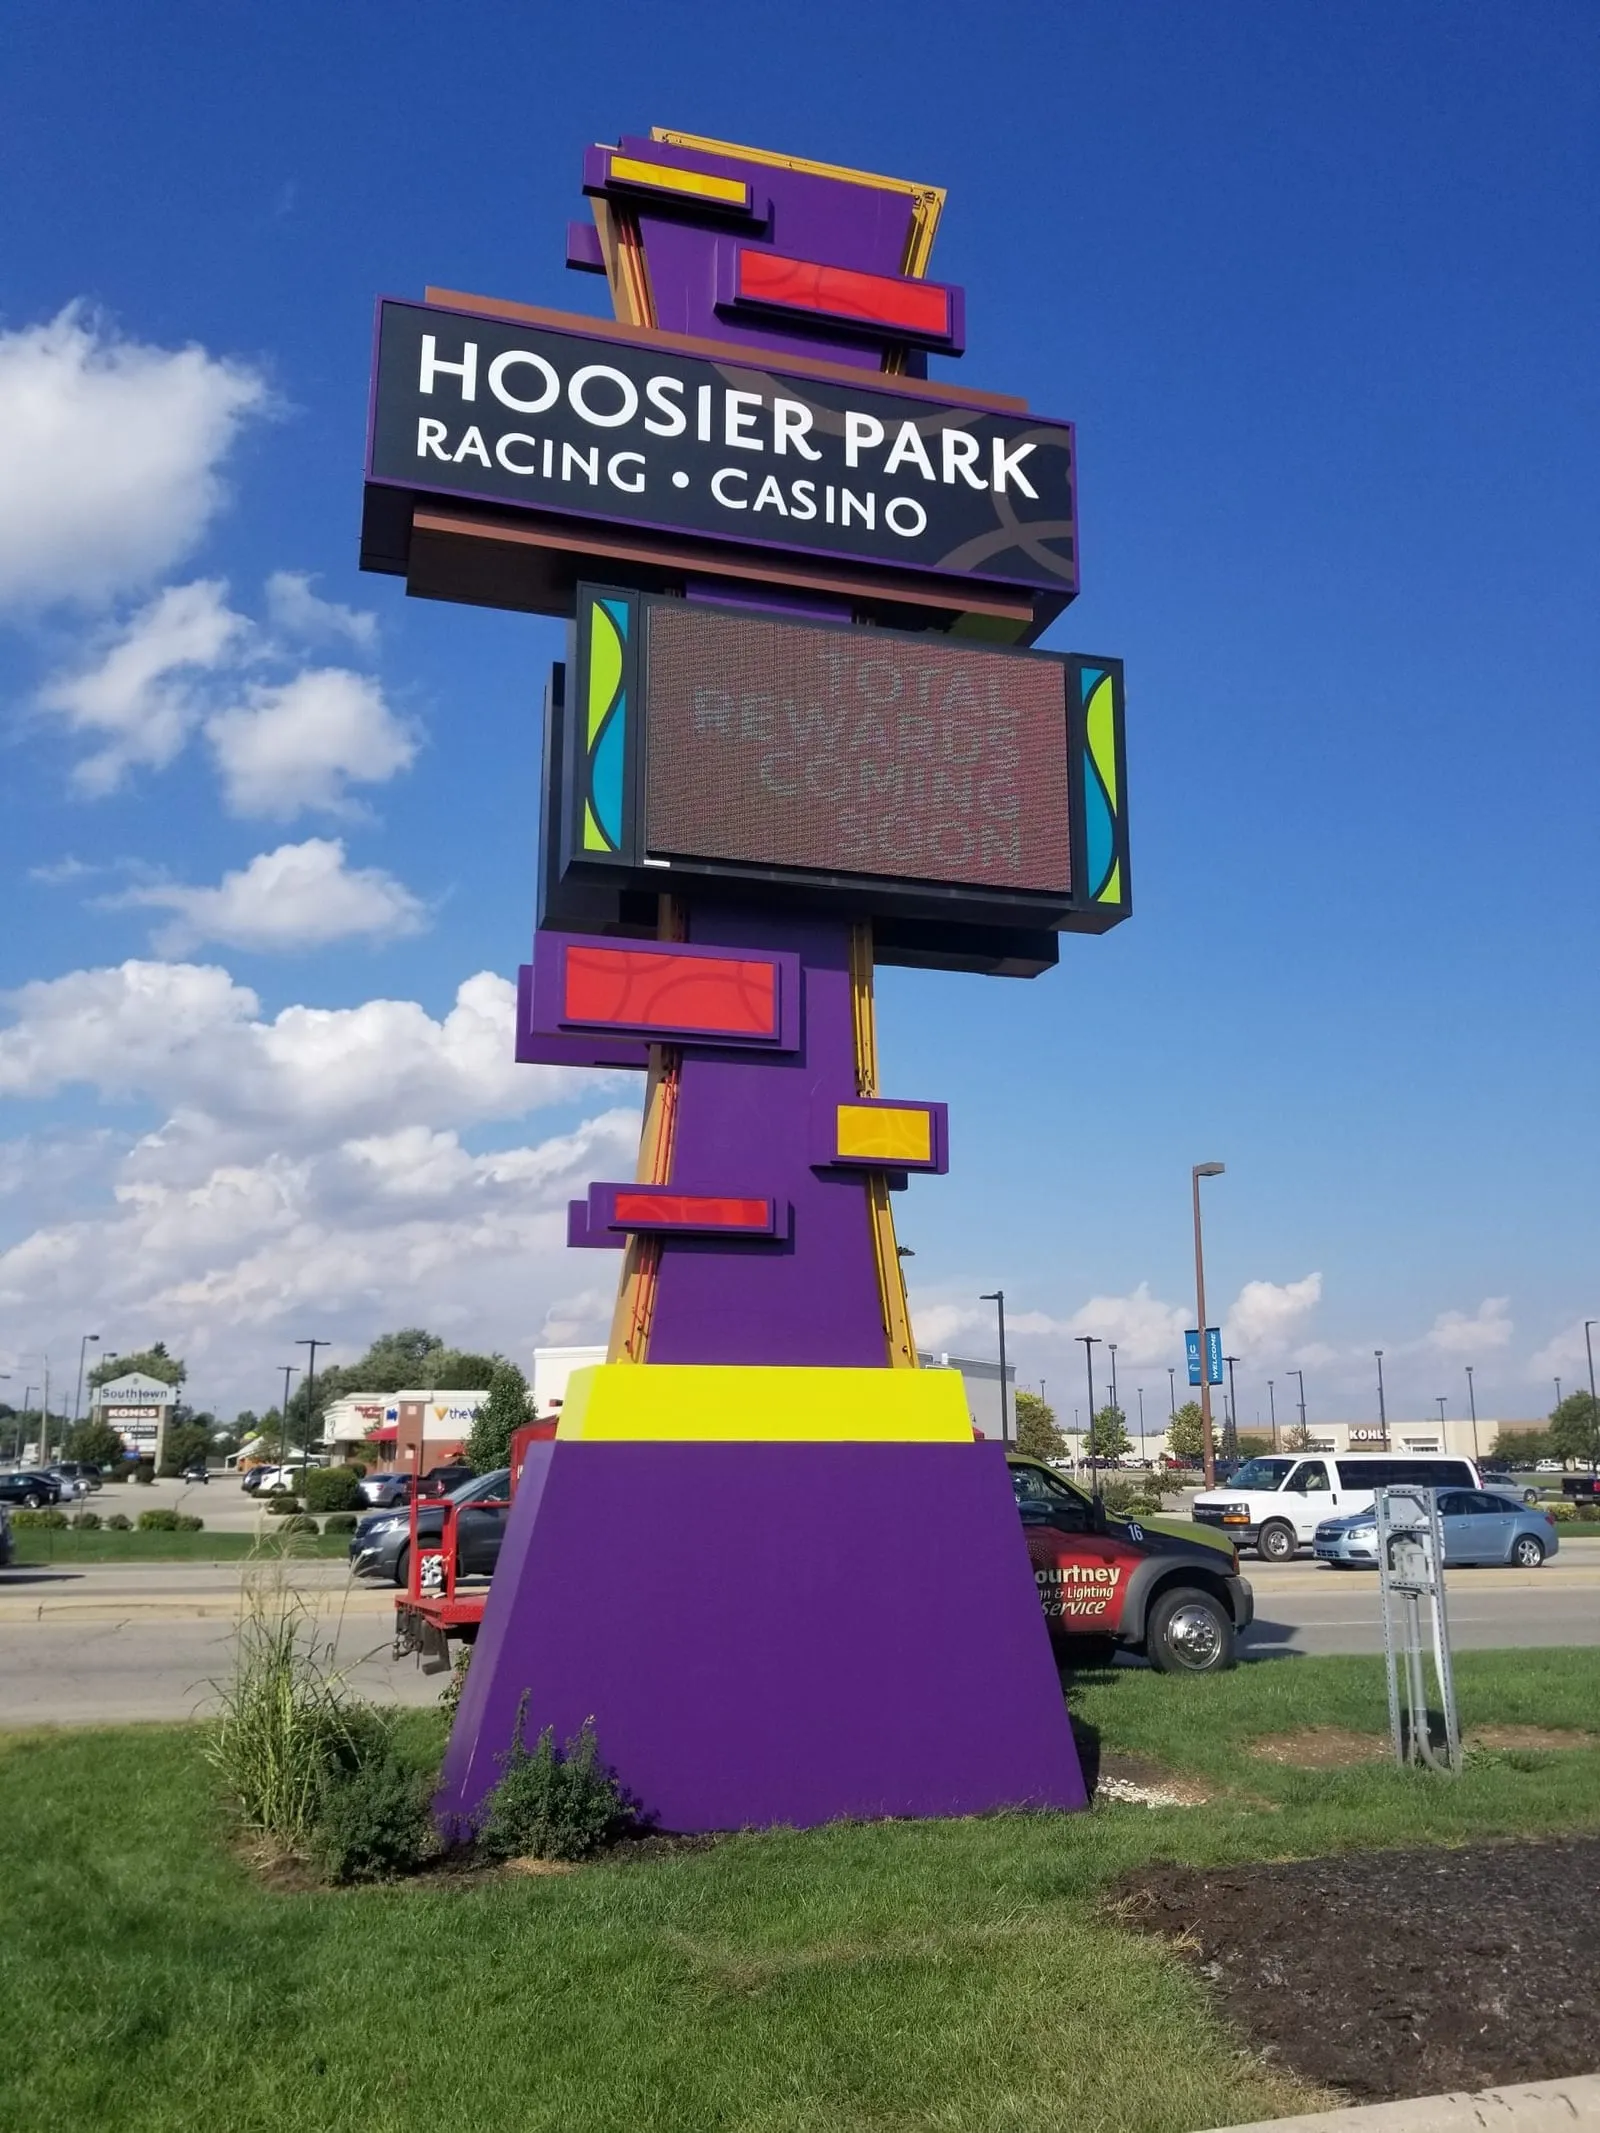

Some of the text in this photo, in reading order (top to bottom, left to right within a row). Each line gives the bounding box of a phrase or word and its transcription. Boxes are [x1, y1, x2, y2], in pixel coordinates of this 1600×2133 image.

[419, 334, 1041, 500] HOOSIER PARK
[416, 417, 929, 538] RACING CASINO
[818, 652, 1021, 720] TOTAL
[691, 686, 1021, 770] REWARDS
[760, 751, 1021, 820] COMING
[838, 809, 1021, 872] SOON
[103, 1388, 167, 1398] Southtown
[108, 1408, 156, 1417] KOHL'S
[1127, 1525, 1142, 1541] 16
[1035, 1564, 1121, 1586] ourtney
[1067, 1585, 1114, 1602] Lighting
